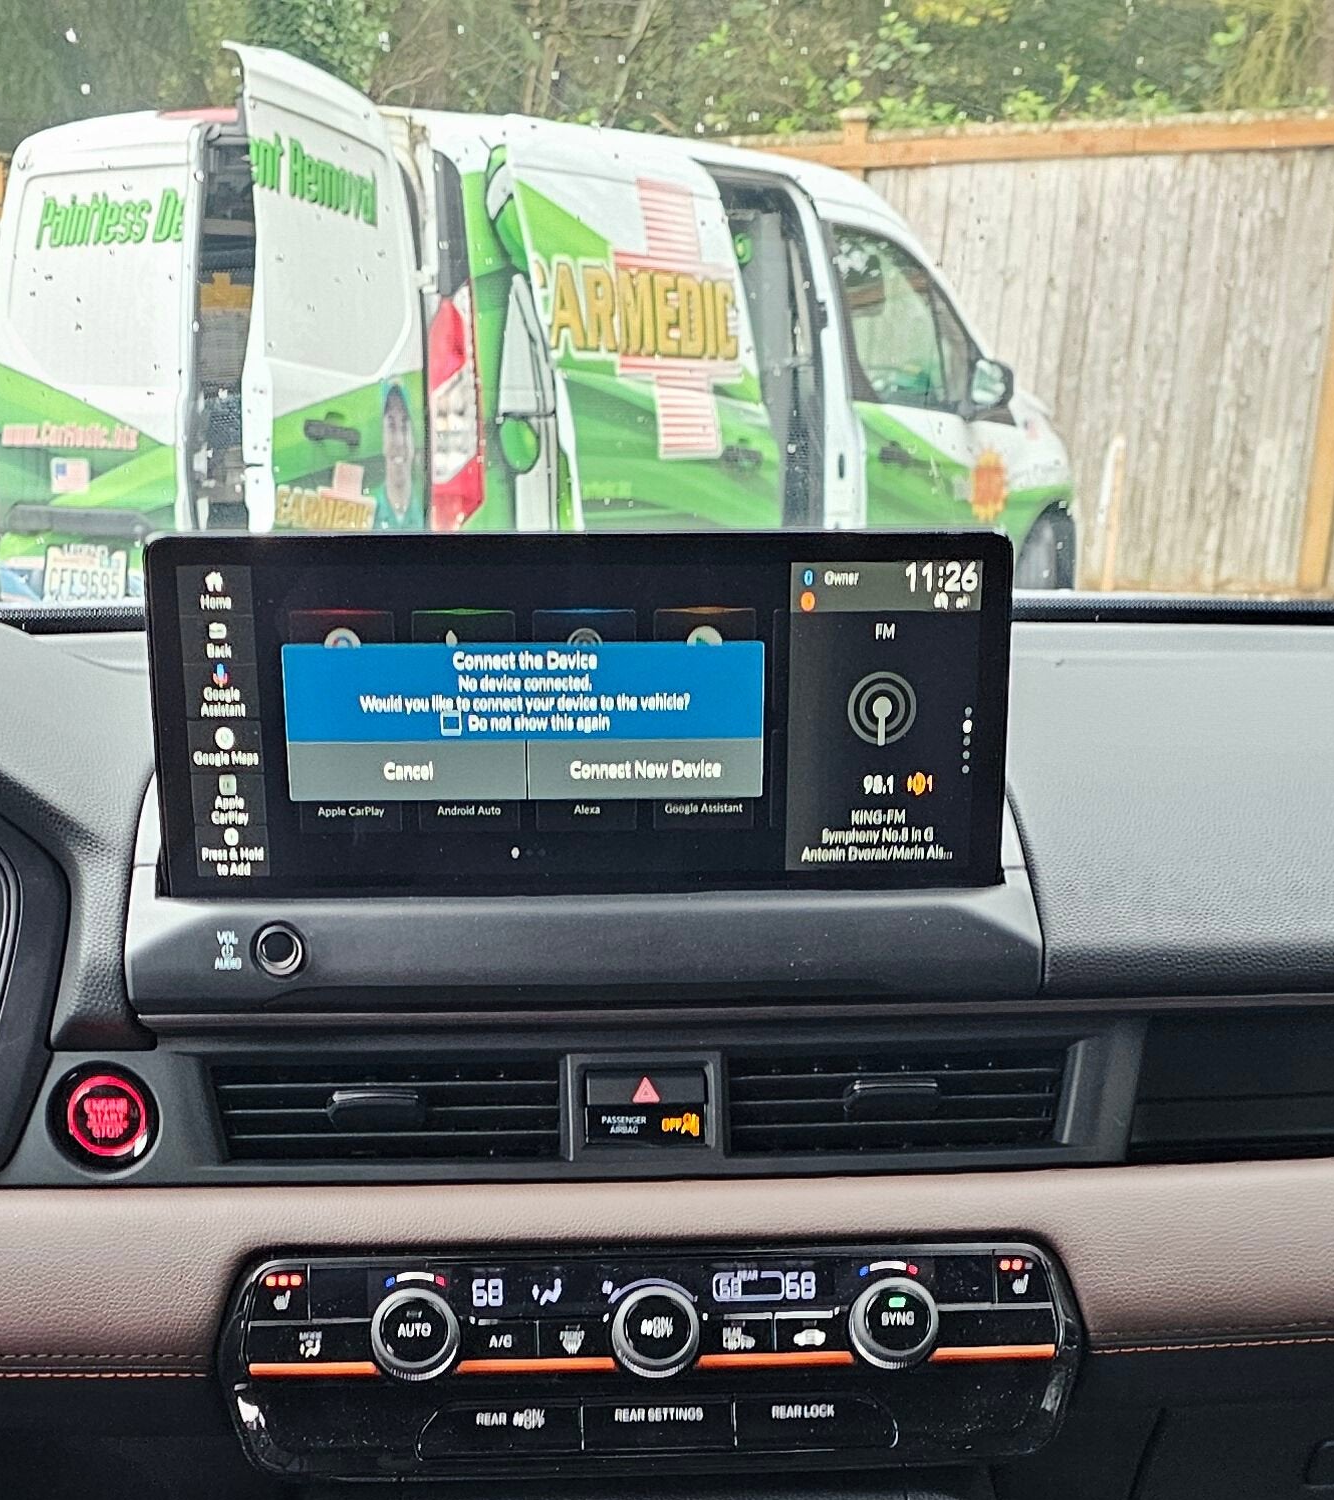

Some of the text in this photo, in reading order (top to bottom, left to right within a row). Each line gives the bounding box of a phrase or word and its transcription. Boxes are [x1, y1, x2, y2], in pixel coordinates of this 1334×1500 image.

[288, 136, 379, 229] Removal
[824, 560, 979, 593] Owner 11:26
[199, 594, 232, 611] Home
[875, 622, 896, 640] FM
[206, 642, 232, 659] Back
[452, 650, 598, 671] Connect the Device
[458, 674, 593, 692] No device connected.
[203, 687, 240, 704] Google
[359, 692, 691, 715] Would you like to connect your device to the vehicle?
[200, 702, 246, 718] Assistant
[468, 713, 611, 734] Do not show this again
[193, 751, 259, 767] Google Maps
[383, 760, 434, 782] Cancel
[570, 758, 722, 780] Connect New Device
[863, 774, 894, 795] 98.1
[214, 795, 245, 811] Apple
[437, 805, 501, 817] Android Auto
[574, 804, 601, 815] Alexa
[664, 802, 743, 815] Google Assistant
[210, 810, 249, 826] CarPlay
[318, 806, 385, 818] Apple CarPlay
[821, 827, 880, 846] Symphony
[911, 827, 922, 843] in
[201, 847, 264, 862] Press & Hold
[801, 846, 847, 863] Antonin
[217, 862, 251, 877] to Add
[217, 931, 239, 945] VOL
[601, 1115, 647, 1124] PASSENGER
[610, 1126, 638, 1134] AIRBAG
[471, 1278, 504, 1307] 68
[785, 1271, 816, 1300] 68
[881, 1311, 914, 1327] SYNC
[397, 1322, 431, 1339] AUTO
[489, 1334, 513, 1348] A/C
[476, 1412, 507, 1427] REAR
[615, 1407, 703, 1422] REAR SETTINGS
[771, 1404, 835, 1419] REAR LOCK
